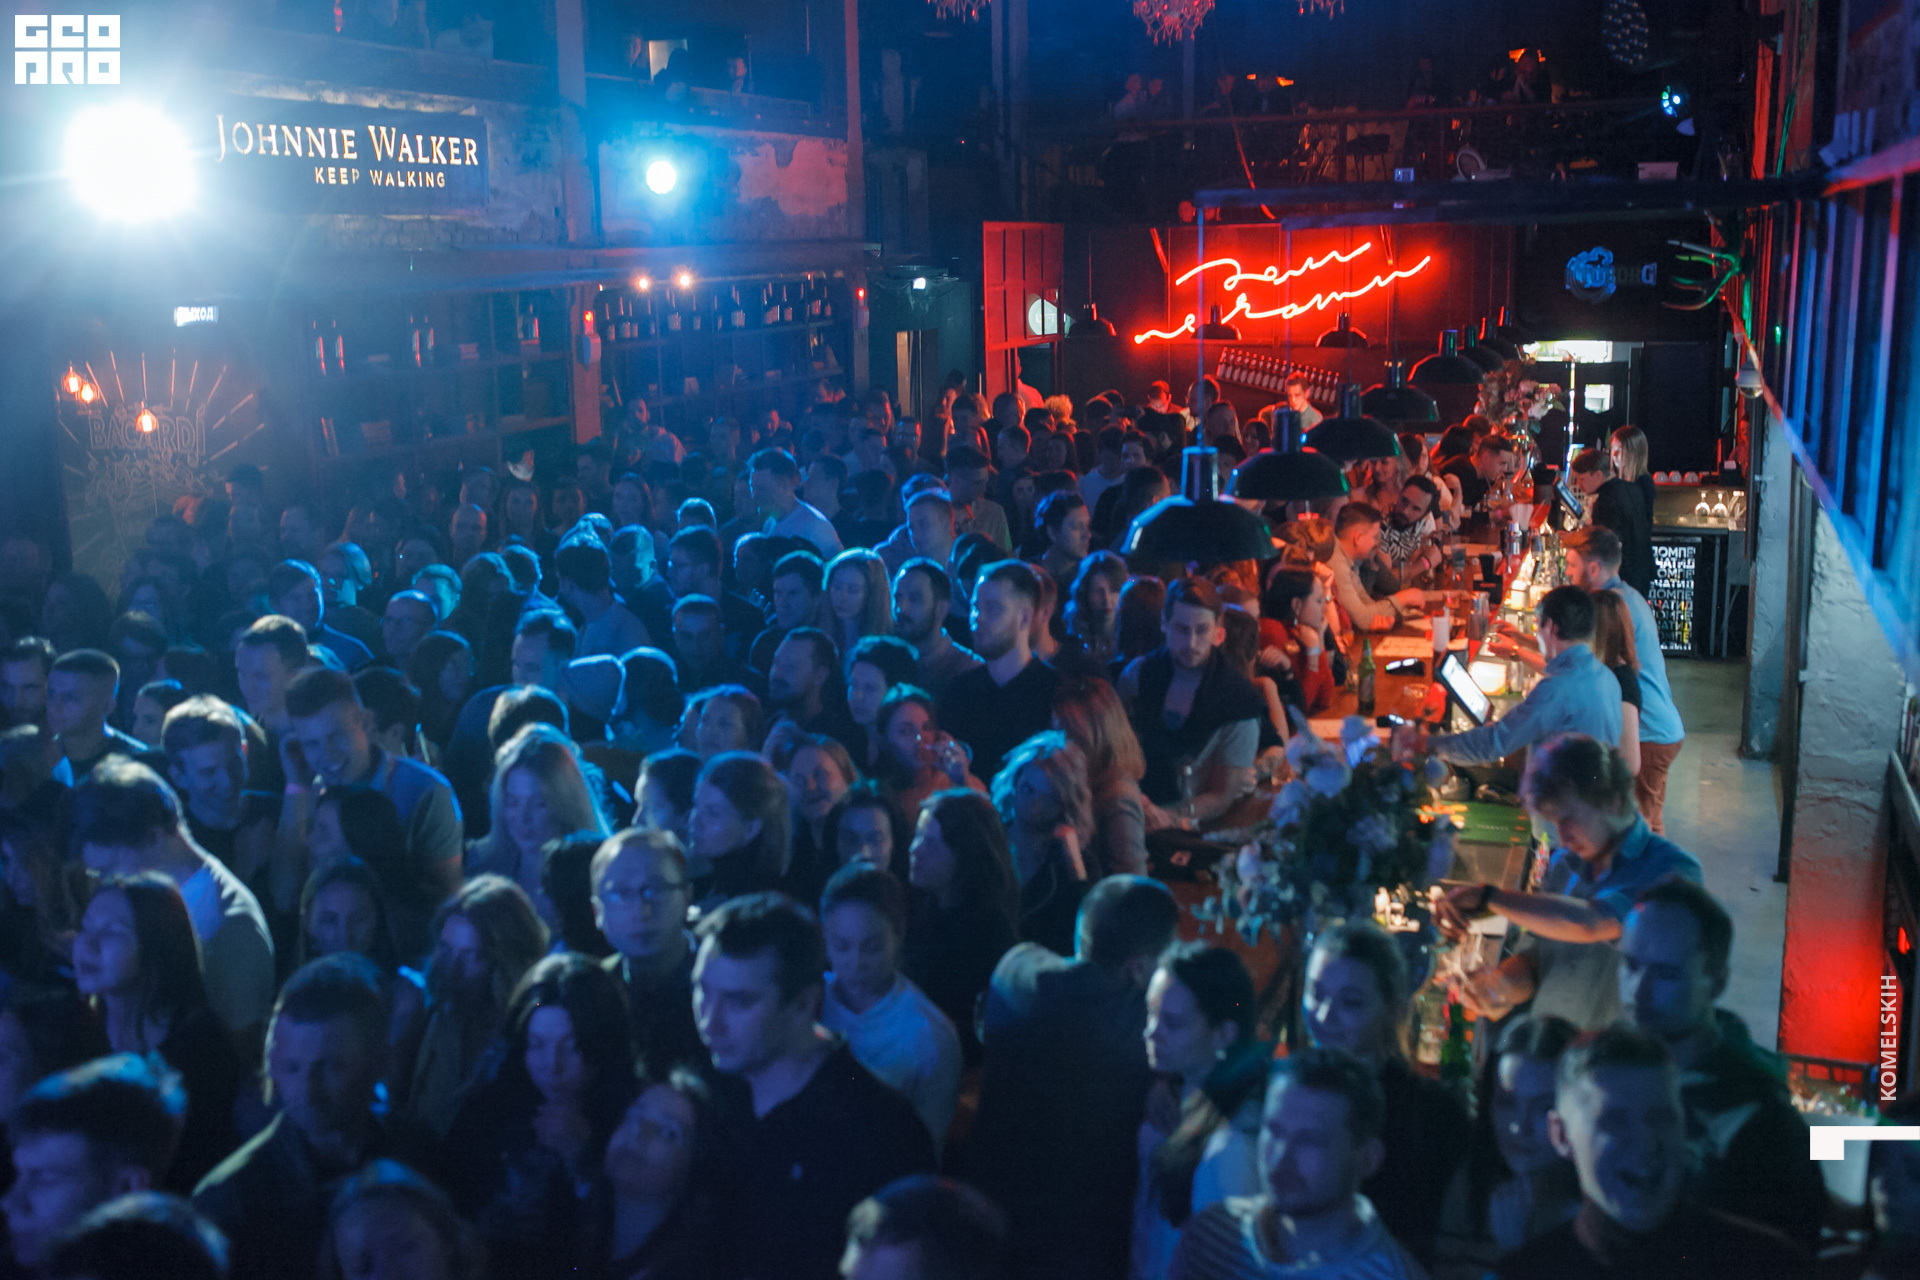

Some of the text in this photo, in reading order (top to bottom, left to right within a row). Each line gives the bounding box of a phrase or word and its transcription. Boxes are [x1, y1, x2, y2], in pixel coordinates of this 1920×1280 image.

[215, 114, 479, 165] JOHNNIE WALKER
[314, 167, 446, 188] KEEP WALKING
